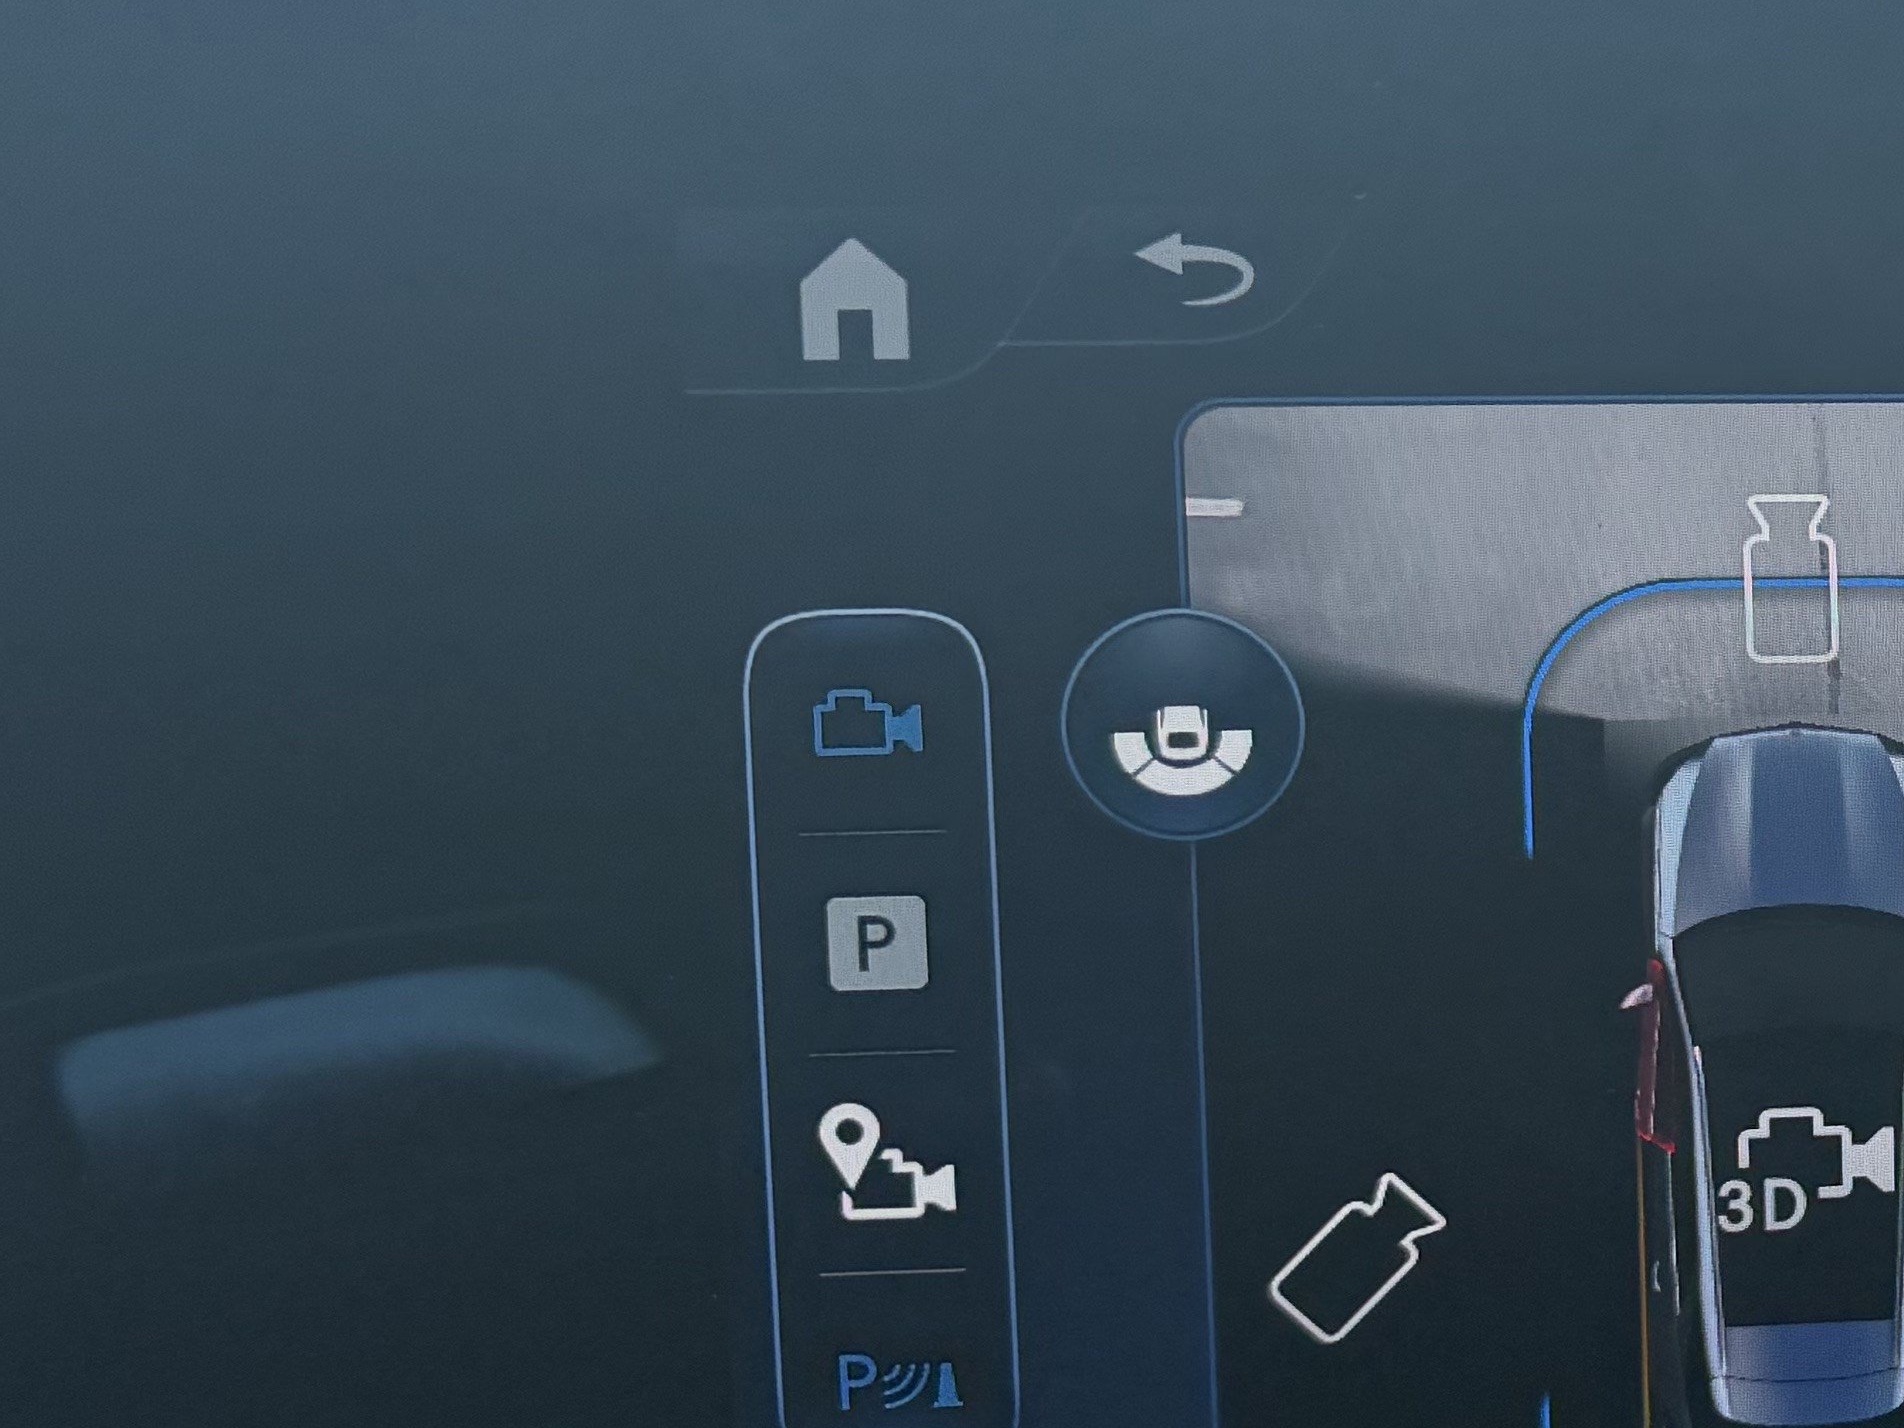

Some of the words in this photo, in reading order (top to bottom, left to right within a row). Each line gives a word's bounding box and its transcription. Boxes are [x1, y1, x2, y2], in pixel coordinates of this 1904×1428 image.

[856, 916, 896, 973] P
[1718, 1178, 1807, 1232] 3D
[838, 1354, 878, 1411] P
